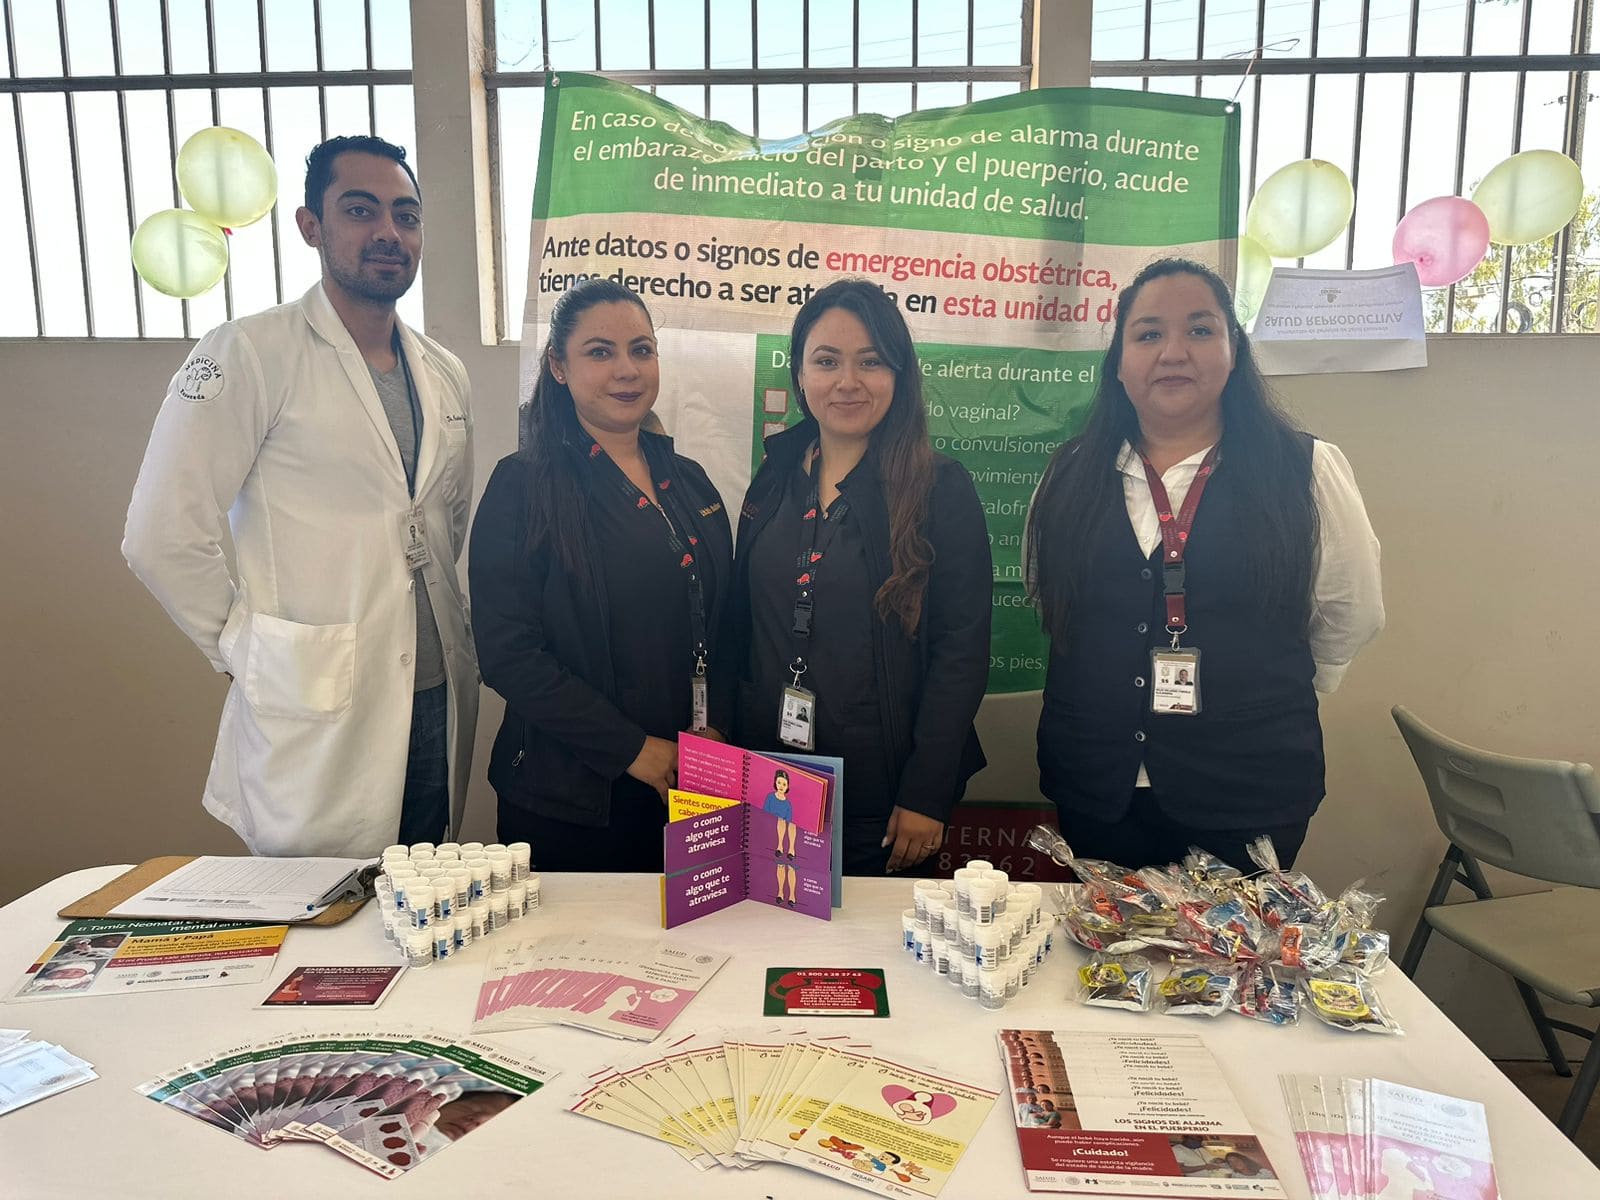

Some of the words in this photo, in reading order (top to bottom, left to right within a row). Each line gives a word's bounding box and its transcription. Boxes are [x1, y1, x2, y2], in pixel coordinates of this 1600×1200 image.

[571, 111, 596, 131] En
[602, 110, 656, 129] caso
[871, 139, 887, 149] o
[893, 134, 962, 153] signo
[970, 129, 1002, 145] de
[1010, 125, 1099, 150] alarma
[1105, 129, 1200, 161] durante
[573, 141, 594, 161] el
[805, 148, 846, 167] del
[852, 153, 924, 173] parto
[932, 157, 948, 177] y
[955, 152, 978, 173] el
[983, 158, 1108, 191] puerperio,
[1114, 171, 1190, 193] acude
[654, 168, 685, 191] de
[691, 167, 824, 198] inmediato
[831, 182, 847, 201] a
[855, 181, 883, 202] tu
[889, 182, 978, 212] unidad
[983, 188, 1013, 213] de
[1019, 195, 1090, 221] salud.
[542, 236, 590, 259] Ante
[594, 233, 668, 260] datos
[674, 241, 691, 260] o
[696, 238, 781, 270] signos
[786, 244, 820, 270] de
[825, 252, 976, 281] emergencia
[982, 257, 1118, 291] obstétrica,
[608, 268, 712, 299] derecho
[717, 283, 734, 301] a
[739, 284, 782, 305] ser
[905, 293, 937, 313] en
[943, 294, 998, 319] esta
[1004, 297, 1089, 322] unidad
[938, 363, 993, 379] alerta
[998, 363, 1073, 383] durante
[1078, 366, 1095, 383] el
[949, 404, 1020, 424] vaginal?
[935, 438, 946, 450] o
[968, 467, 1041, 485] ovimient
[673, 795, 700, 807] Sientes
[693, 821, 700, 829] o
[700, 815, 722, 827] como
[685, 832, 704, 843] algo
[704, 828, 720, 838] que
[688, 837, 726, 853] atraviesa
[700, 866, 723, 880] como
[685, 885, 704, 896] algo
[705, 878, 721, 890] que
[721, 873, 730, 883] te
[688, 887, 727, 907] atraviesa
[128, 921, 184, 930] Neonatal
[170, 922, 218, 931] mental
[131, 936, 172, 945] Mamá
[184, 933, 214, 941] Papá
[1072, 1148, 1129, 1157] ¡Cuidado!
[818, 1160, 841, 1171] SALUD
